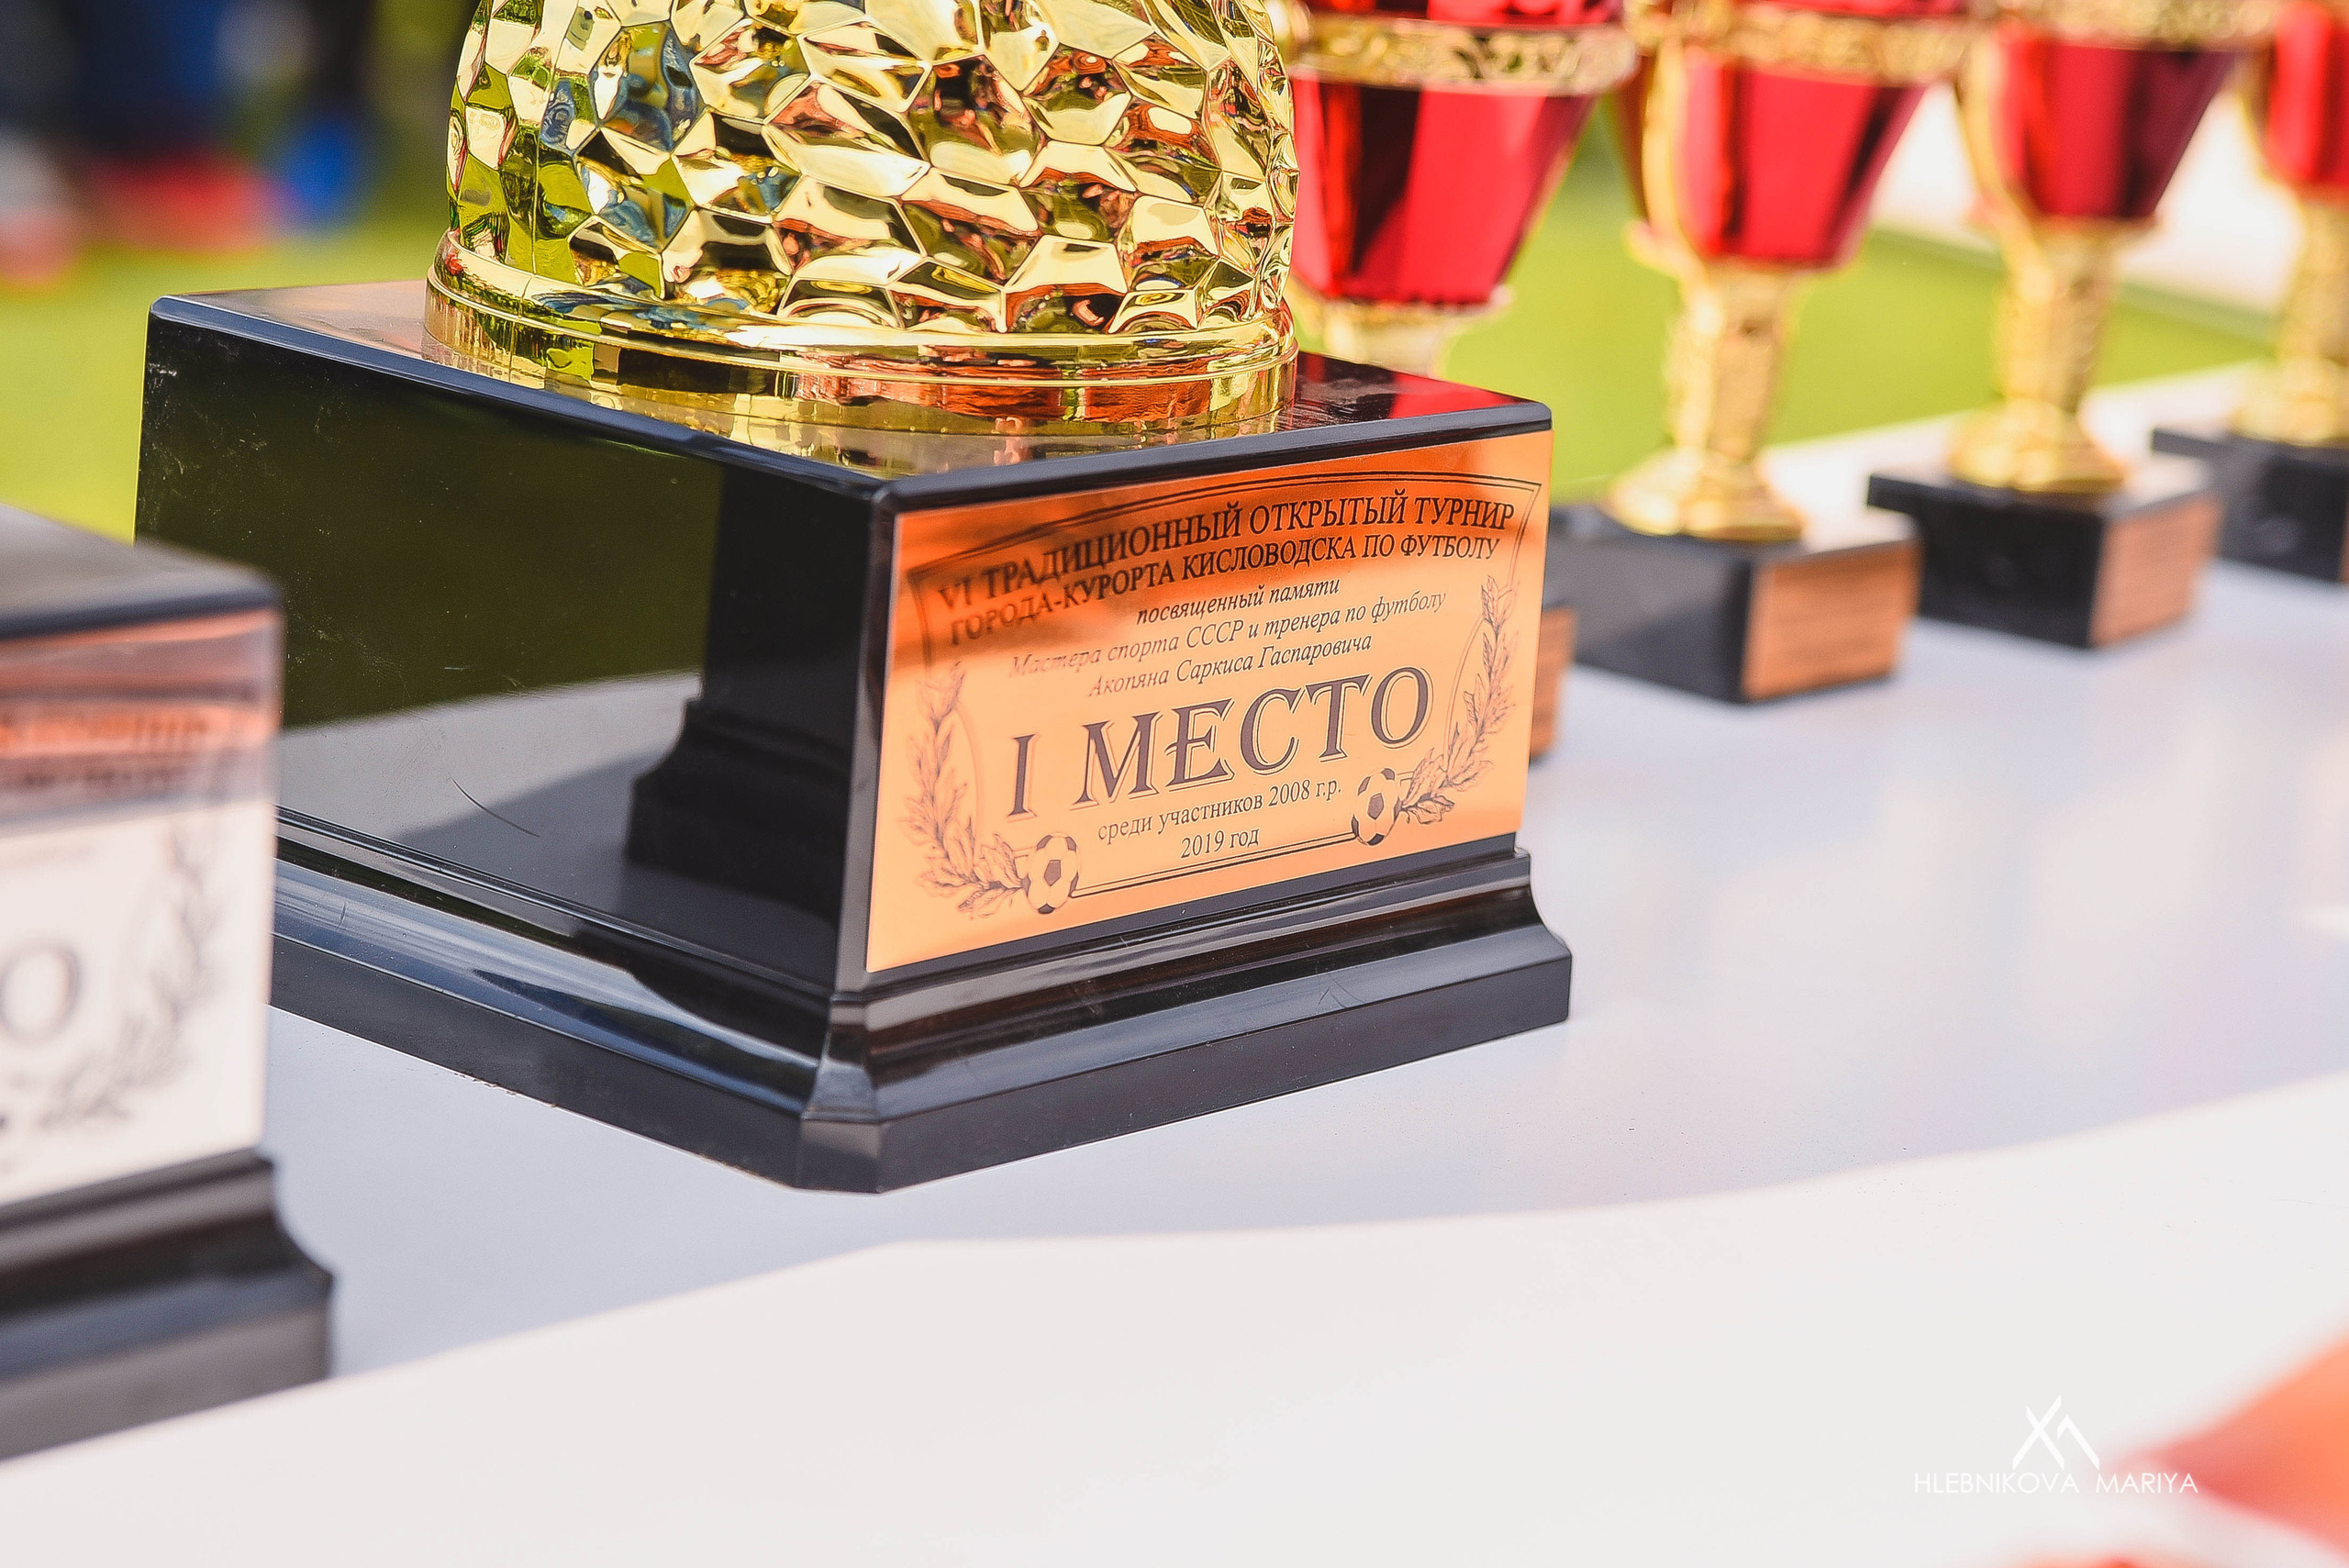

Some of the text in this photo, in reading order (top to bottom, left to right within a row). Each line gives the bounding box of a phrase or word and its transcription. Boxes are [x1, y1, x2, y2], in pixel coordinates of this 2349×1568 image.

[982, 501, 1242, 600] ТРАДИЦИОННЫЙ
[1250, 488, 1408, 534] ОТКРЫТЫЙ
[1414, 496, 1515, 530] ТУРНИР
[951, 534, 1499, 645] ГОРОДА-КУРОРТА КИСЛОВОДСКА ПО ФУТБОЛУ
[1136, 578, 1340, 625] посвященный памяти
[1009, 590, 1446, 677] Мастера спорта СССР и тренера по футболу
[1088, 635, 1373, 697] Акопяна Саркиса Гаспаровича
[1071, 666, 1433, 810] МЕСТО
[1098, 780, 1341, 845] среди участников 2008 г.р.
[1181, 828, 1259, 859] 2019 год
